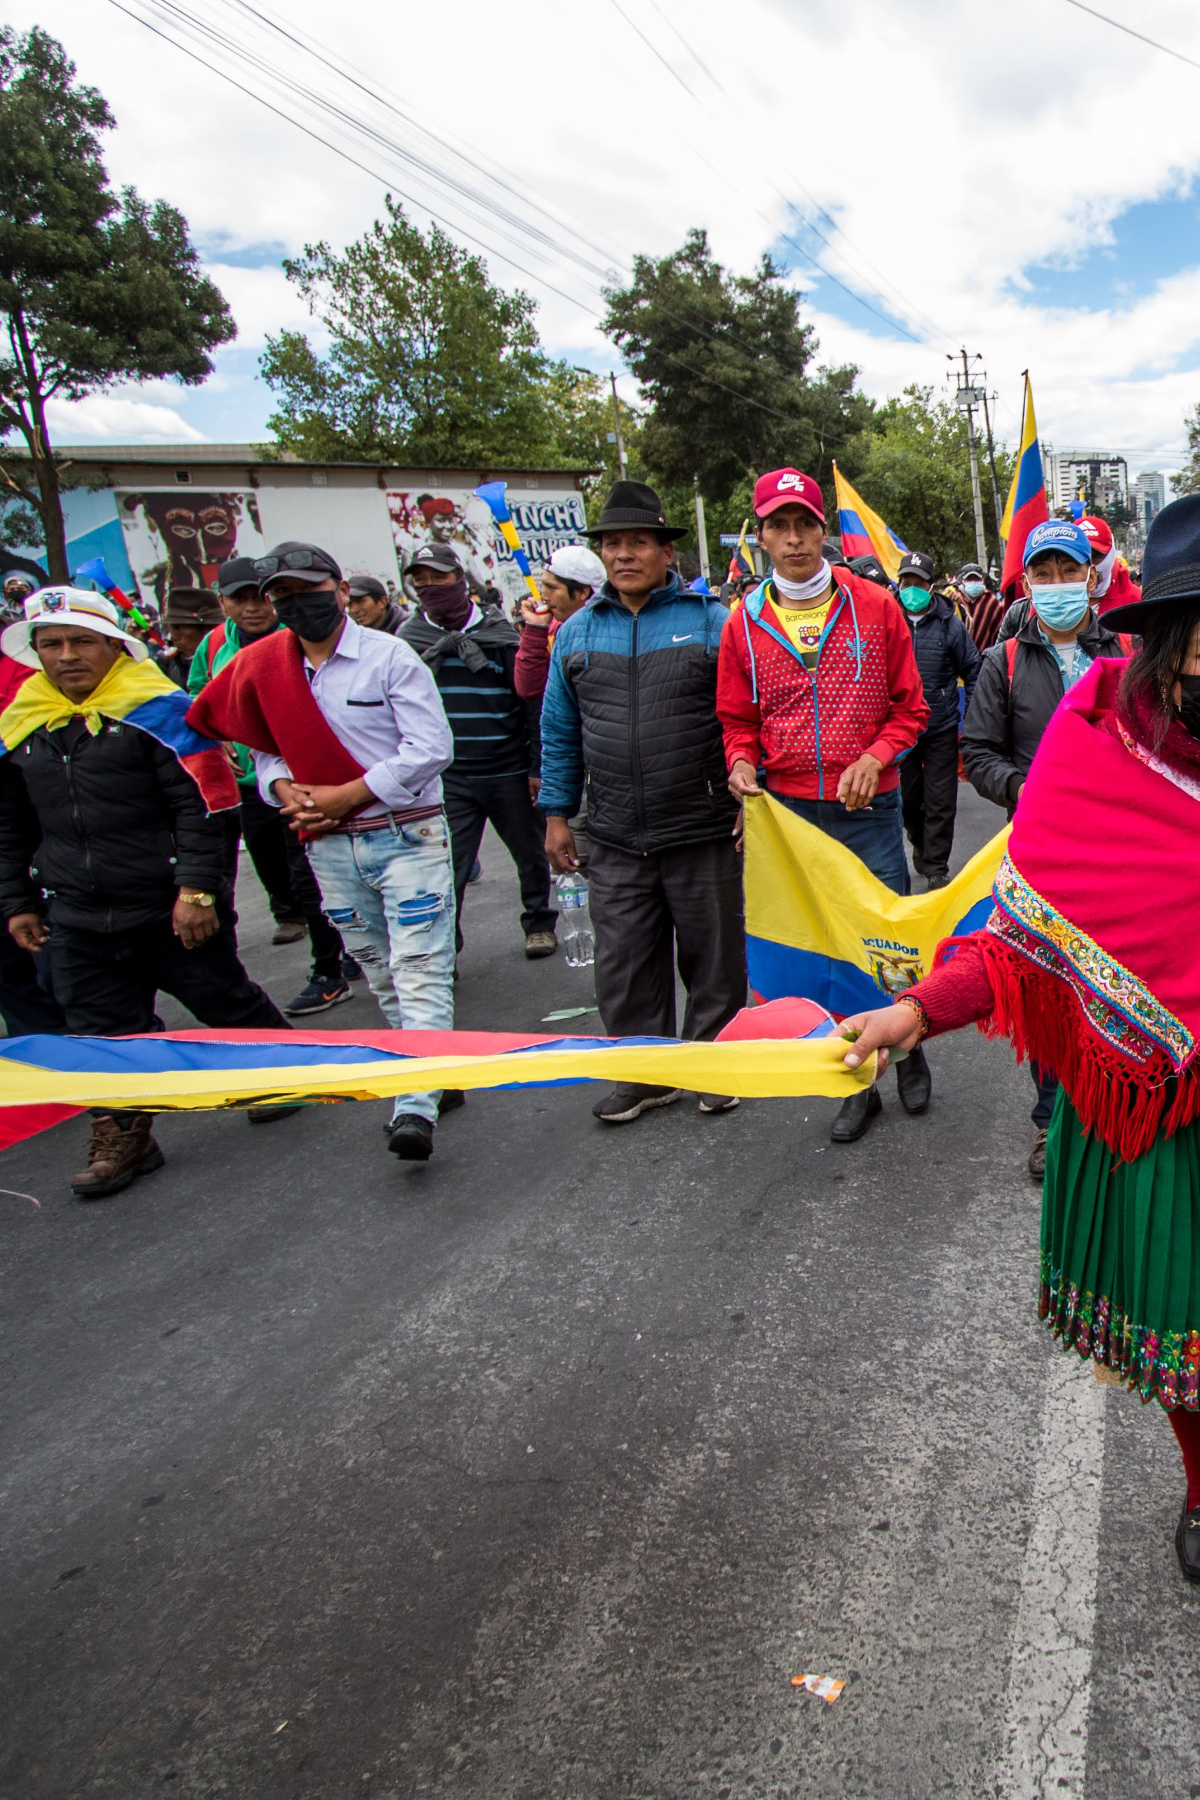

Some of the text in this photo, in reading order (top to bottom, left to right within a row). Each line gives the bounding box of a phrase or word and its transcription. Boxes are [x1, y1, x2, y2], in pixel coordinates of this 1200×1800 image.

[781, 473, 801, 483] NIKE
[911, 553, 922, 566] LA
[785, 610, 828, 622] Barcelona
